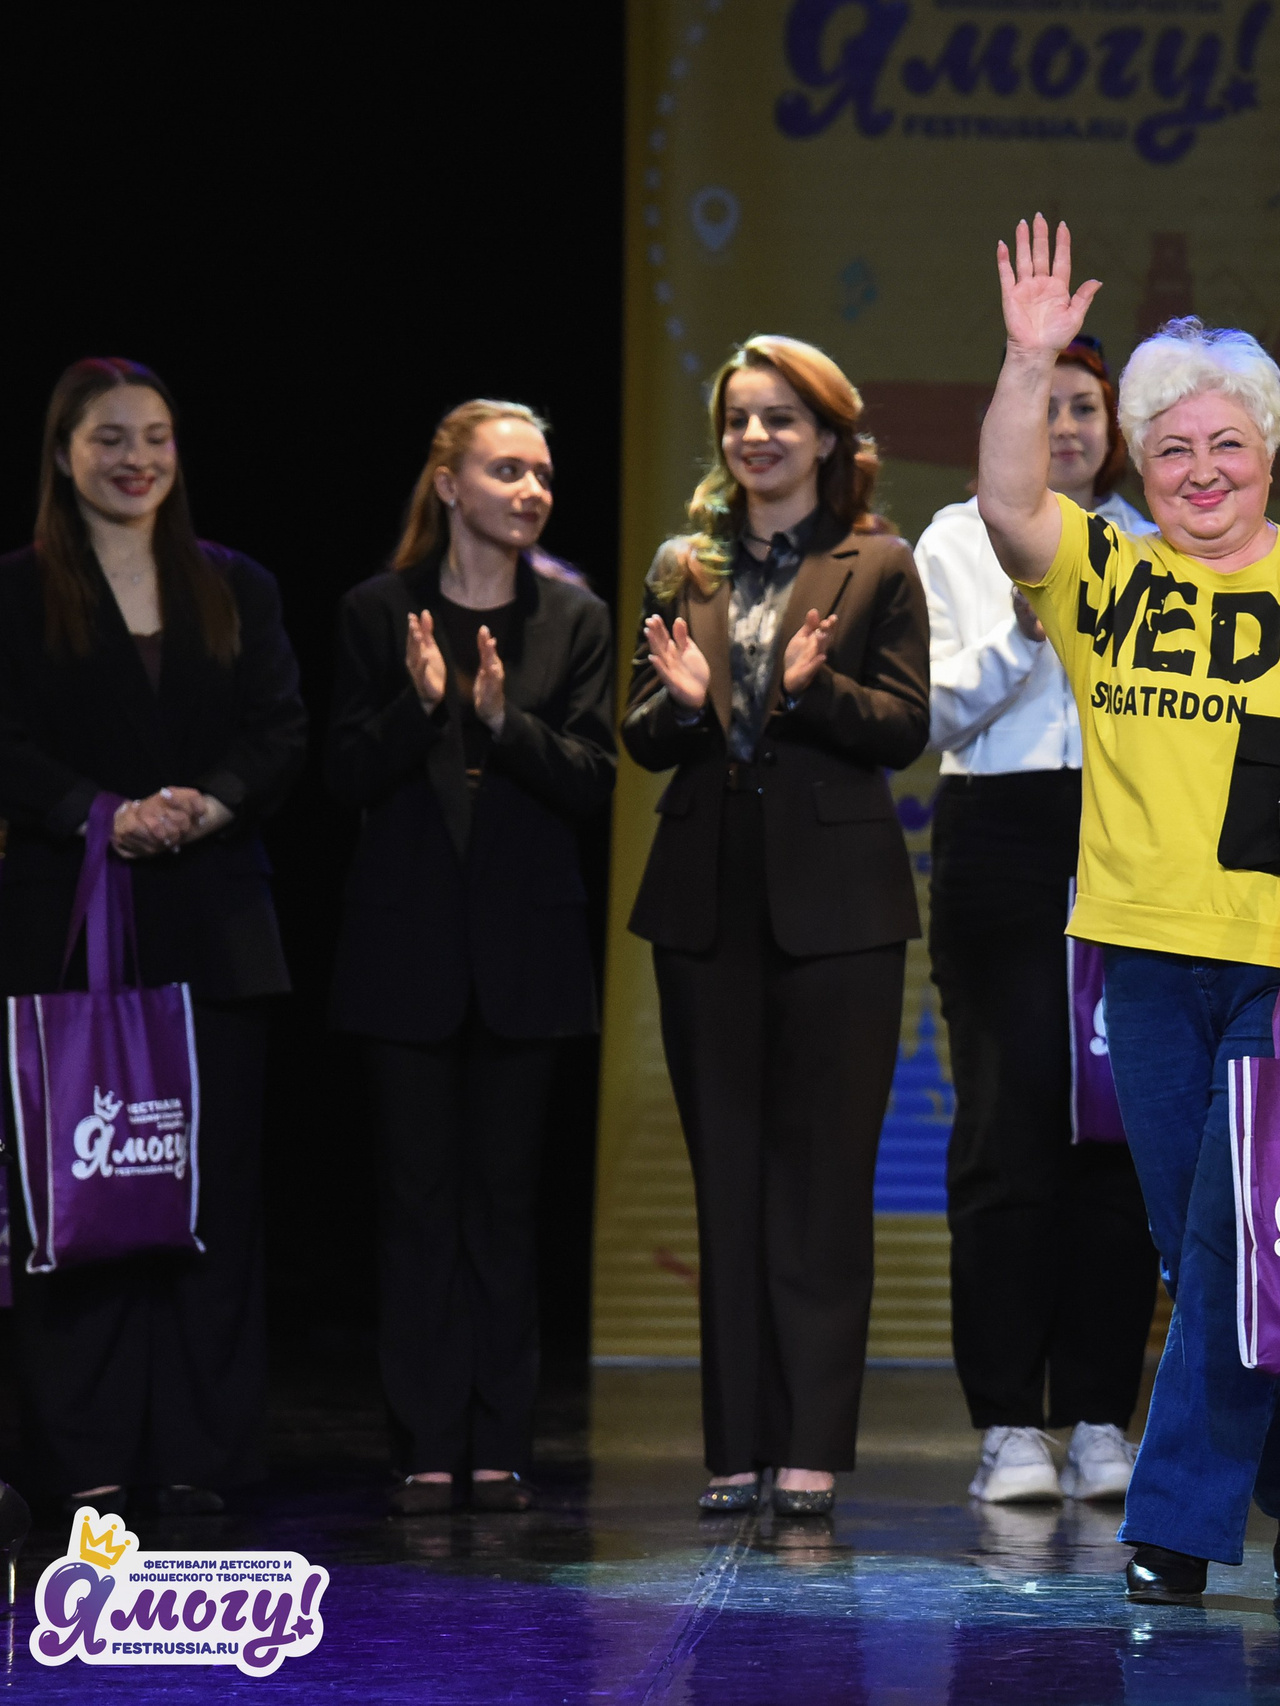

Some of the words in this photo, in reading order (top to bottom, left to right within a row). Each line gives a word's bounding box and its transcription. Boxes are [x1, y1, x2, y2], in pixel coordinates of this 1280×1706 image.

[774, 0, 909, 140] Я
[902, 0, 1274, 165] могу!
[71, 1115, 116, 1180] Я
